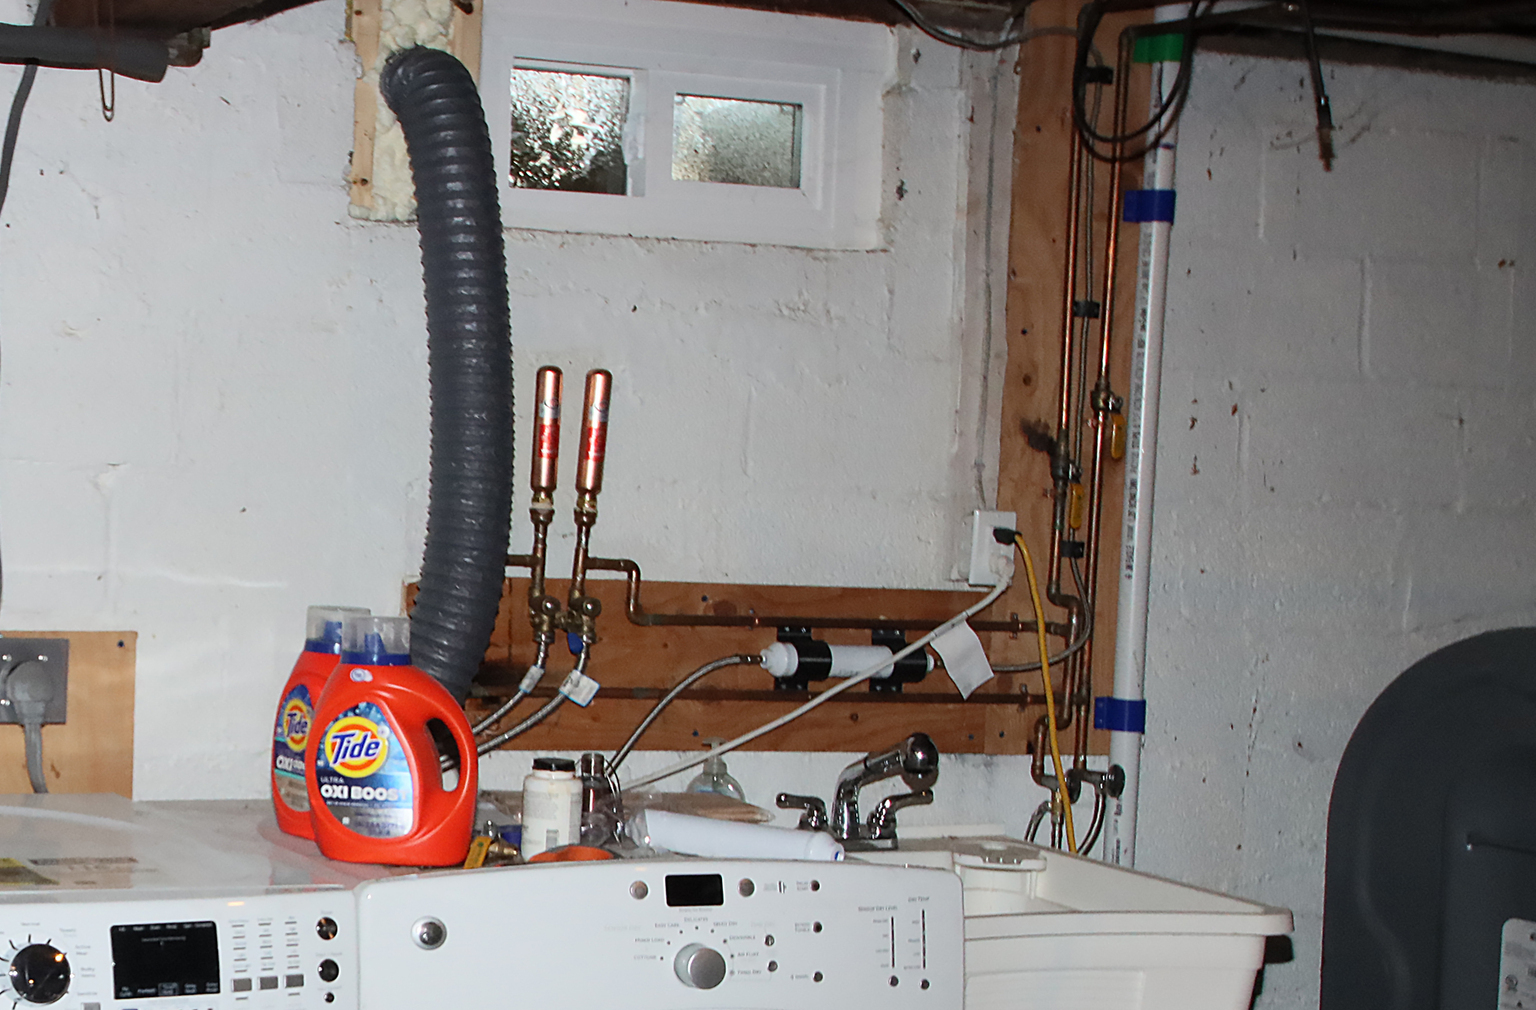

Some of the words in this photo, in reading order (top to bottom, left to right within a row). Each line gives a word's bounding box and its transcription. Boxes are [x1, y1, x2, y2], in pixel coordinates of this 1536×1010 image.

[286, 711, 309, 738] Tide
[330, 731, 381, 766] Tide
[320, 785, 349, 799] OXI
[350, 786, 407, 800] BOOST
